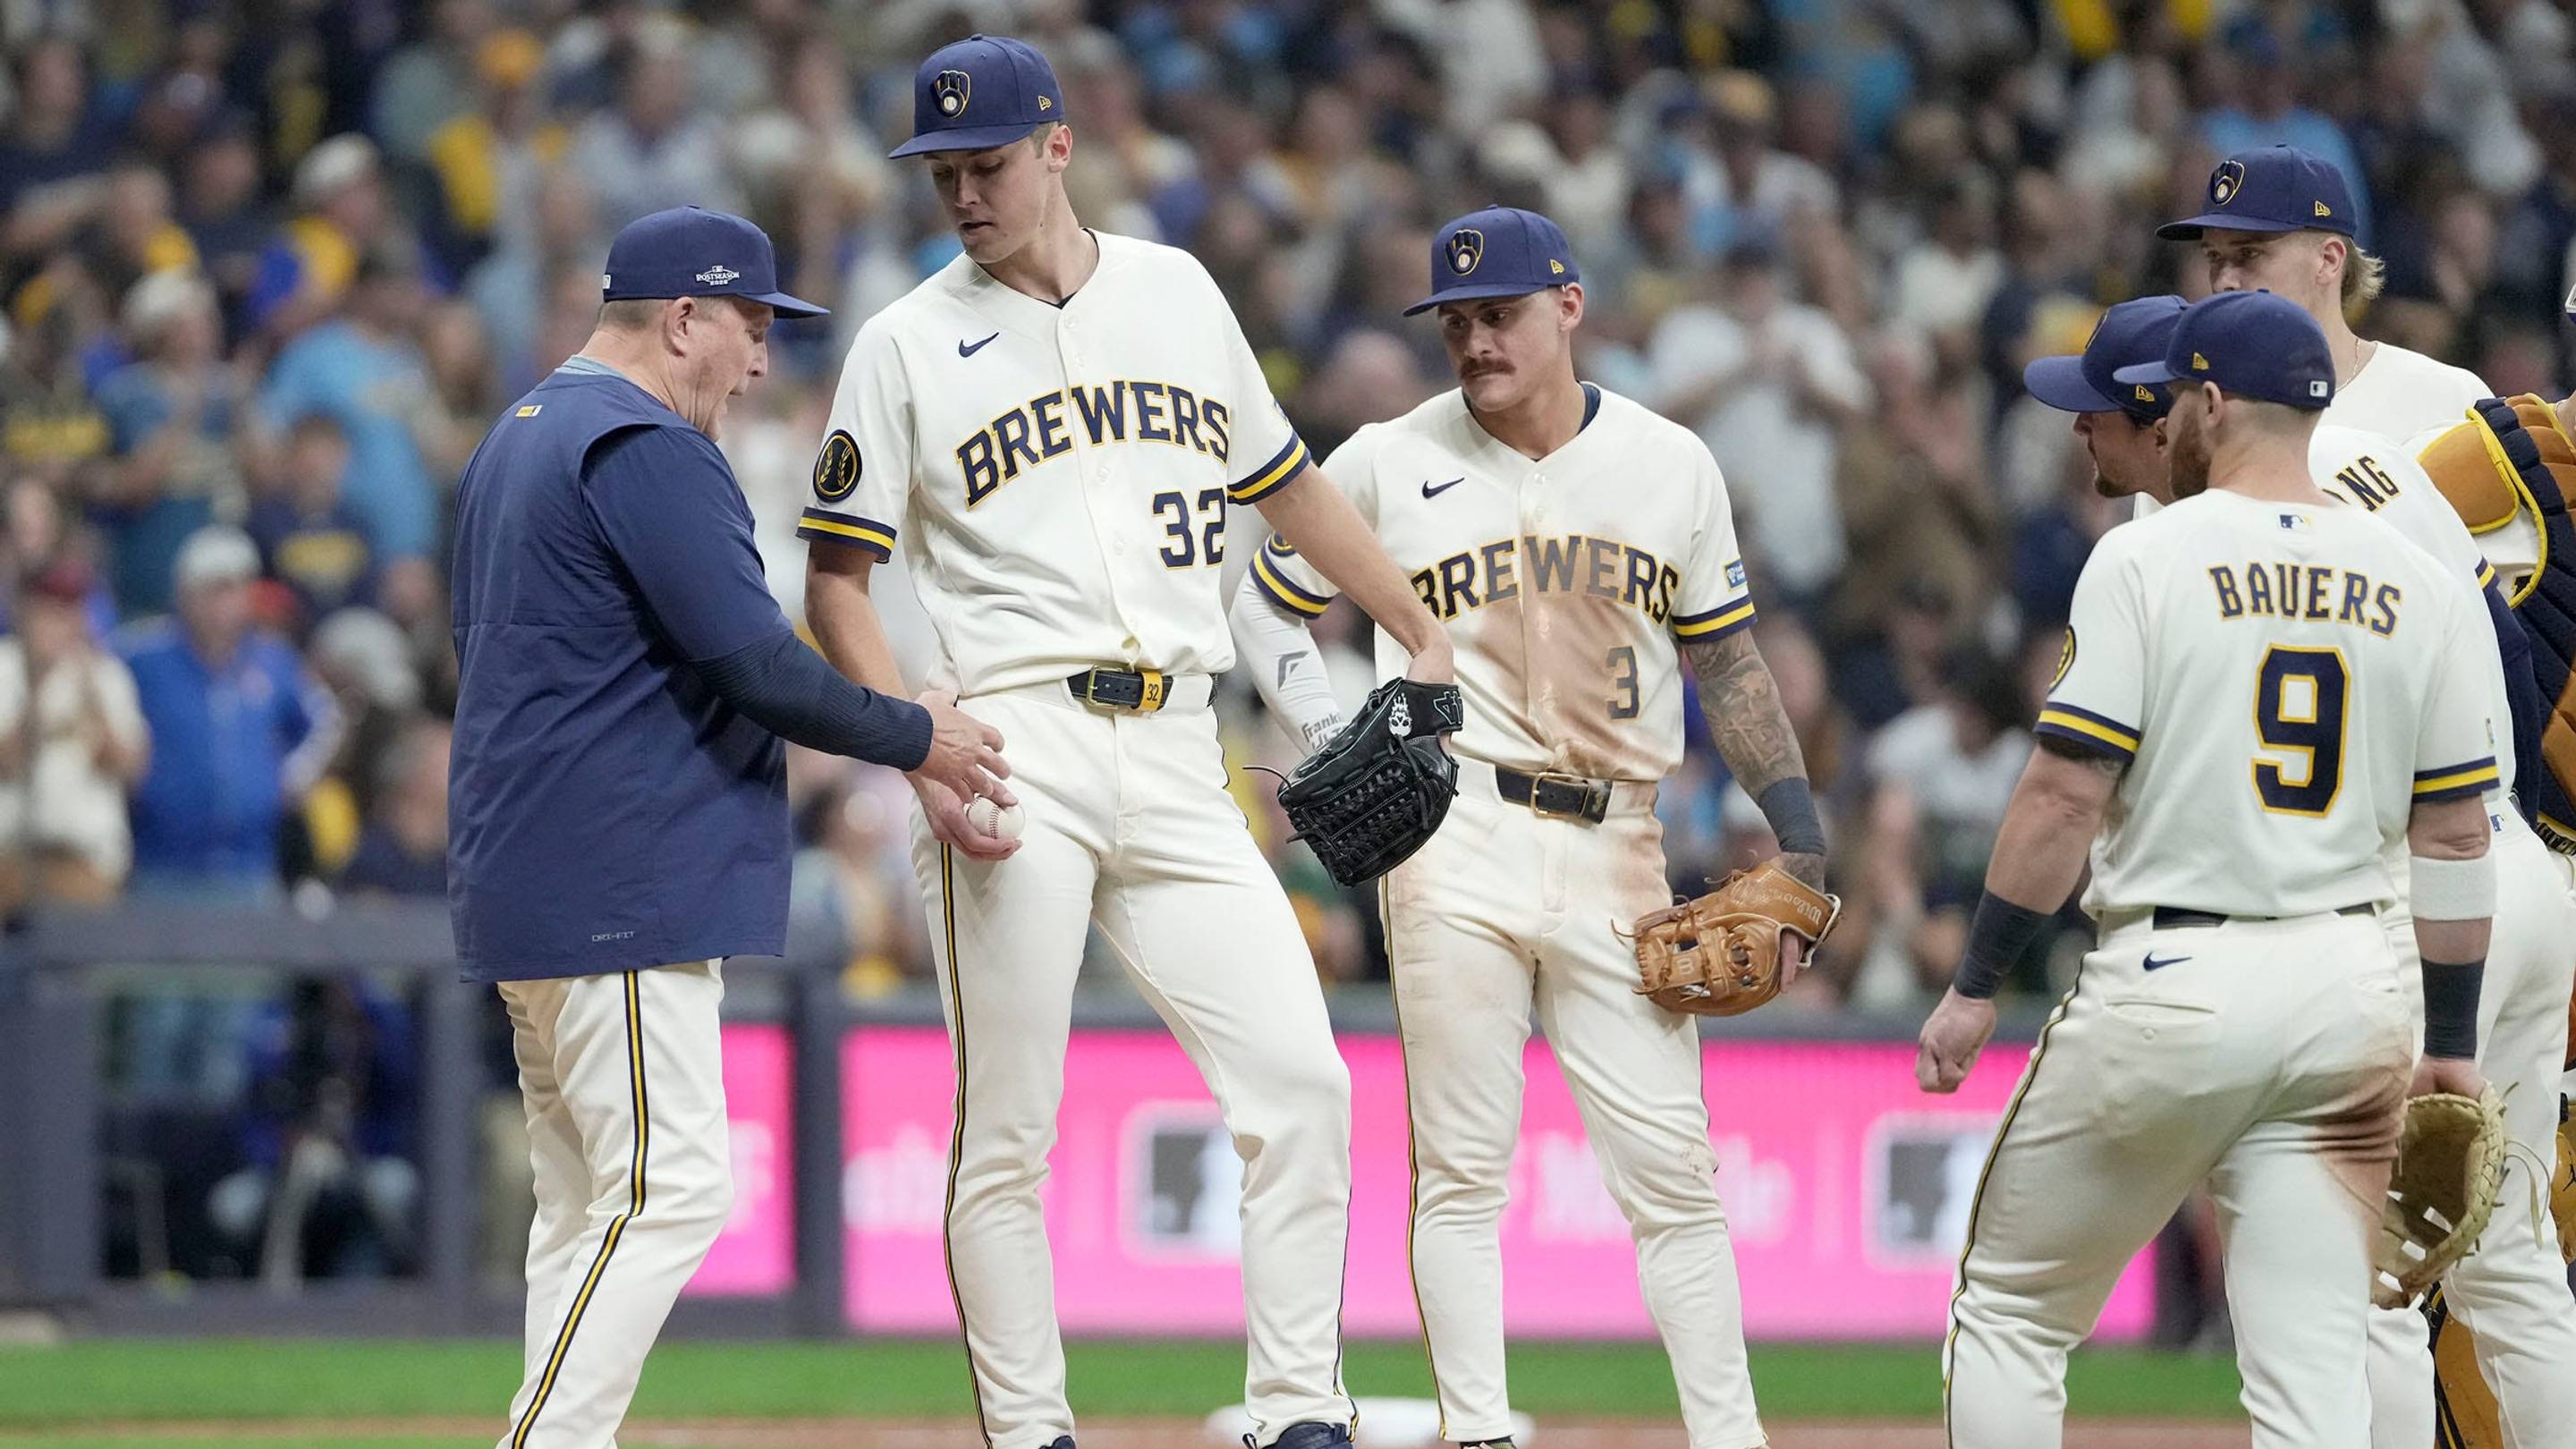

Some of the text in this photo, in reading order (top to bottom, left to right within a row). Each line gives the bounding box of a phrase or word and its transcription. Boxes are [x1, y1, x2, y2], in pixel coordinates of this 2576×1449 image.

[696, 272, 740, 281] POSTSEASON
[954, 378, 1231, 512] BREWERS
[2323, 454, 2402, 513] NG
[1150, 486, 1227, 572] 32
[2207, 562, 2402, 640] BAUERS
[1146, 683, 1160, 702] 32
[1605, 644, 1641, 722] 3
[2250, 642, 2351, 819] 9
[591, 930, 636, 943] DRI-FIT
